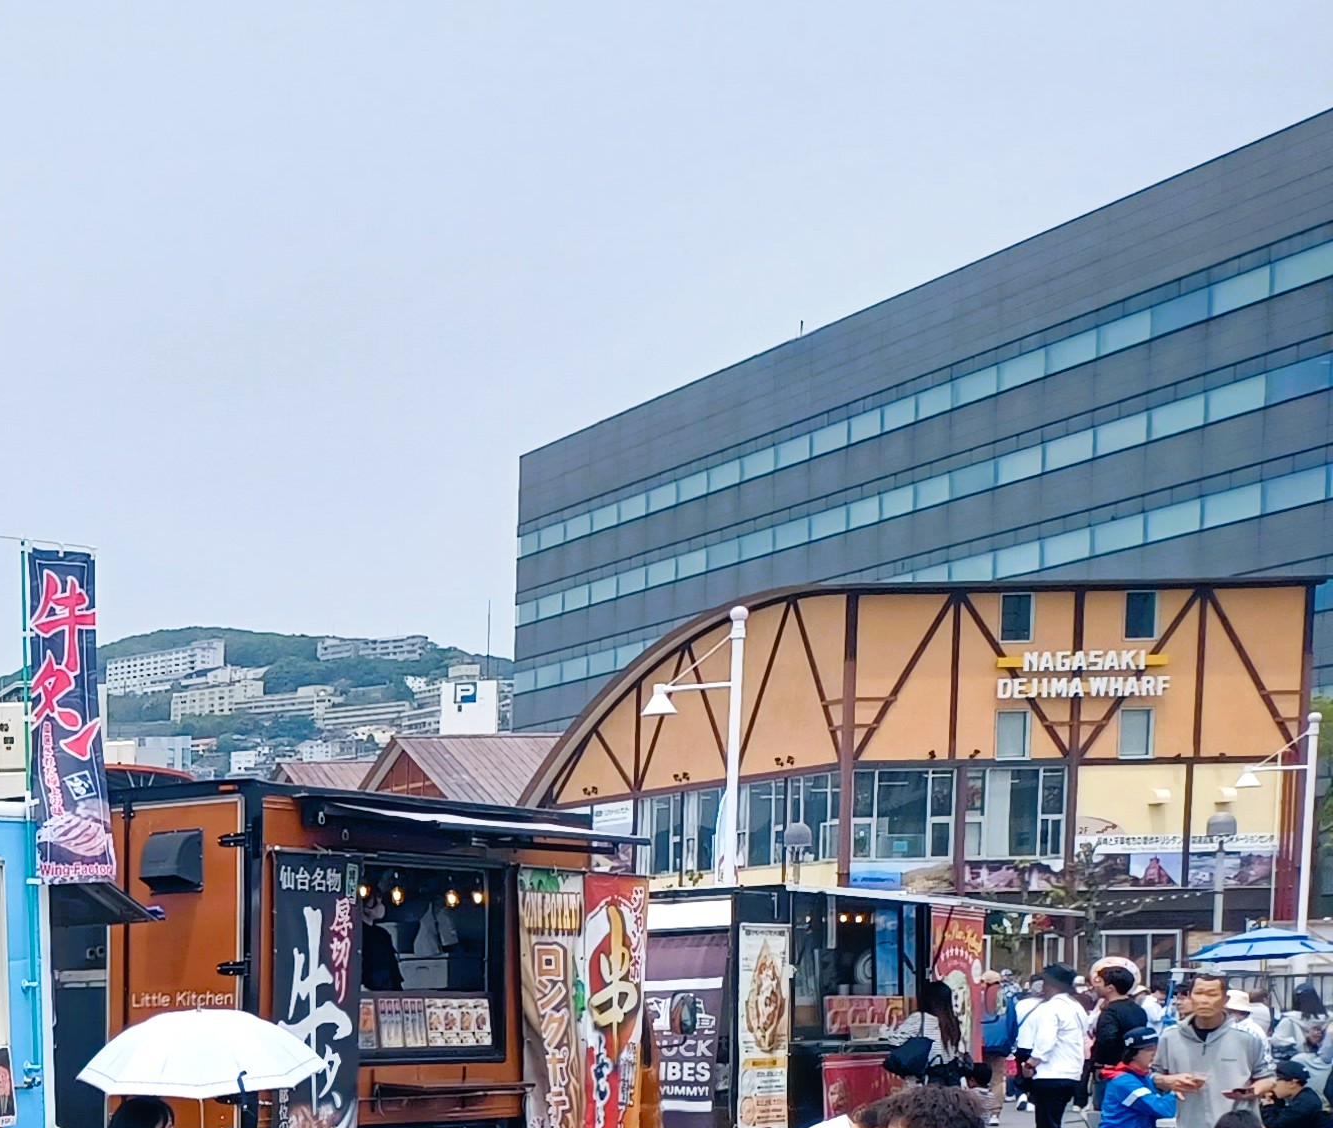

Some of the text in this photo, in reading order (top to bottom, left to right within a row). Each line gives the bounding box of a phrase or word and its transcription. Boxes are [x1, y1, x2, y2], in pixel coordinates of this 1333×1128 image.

[31, 569, 101, 760] 牛タン
[1022, 650, 1146, 672] NAGASAKI
[997, 675, 1170, 699] DEJIMA WHARF
[40, 863, 73, 878] Wing
[279, 865, 342, 892] 仙台名物
[329, 897, 353, 1004] 厚切り
[131, 989, 234, 1009] Little Kitchen
[657, 1039, 714, 1058] UCK
[659, 1061, 711, 1083] IBES
[659, 1085, 709, 1097] YUMMY!
